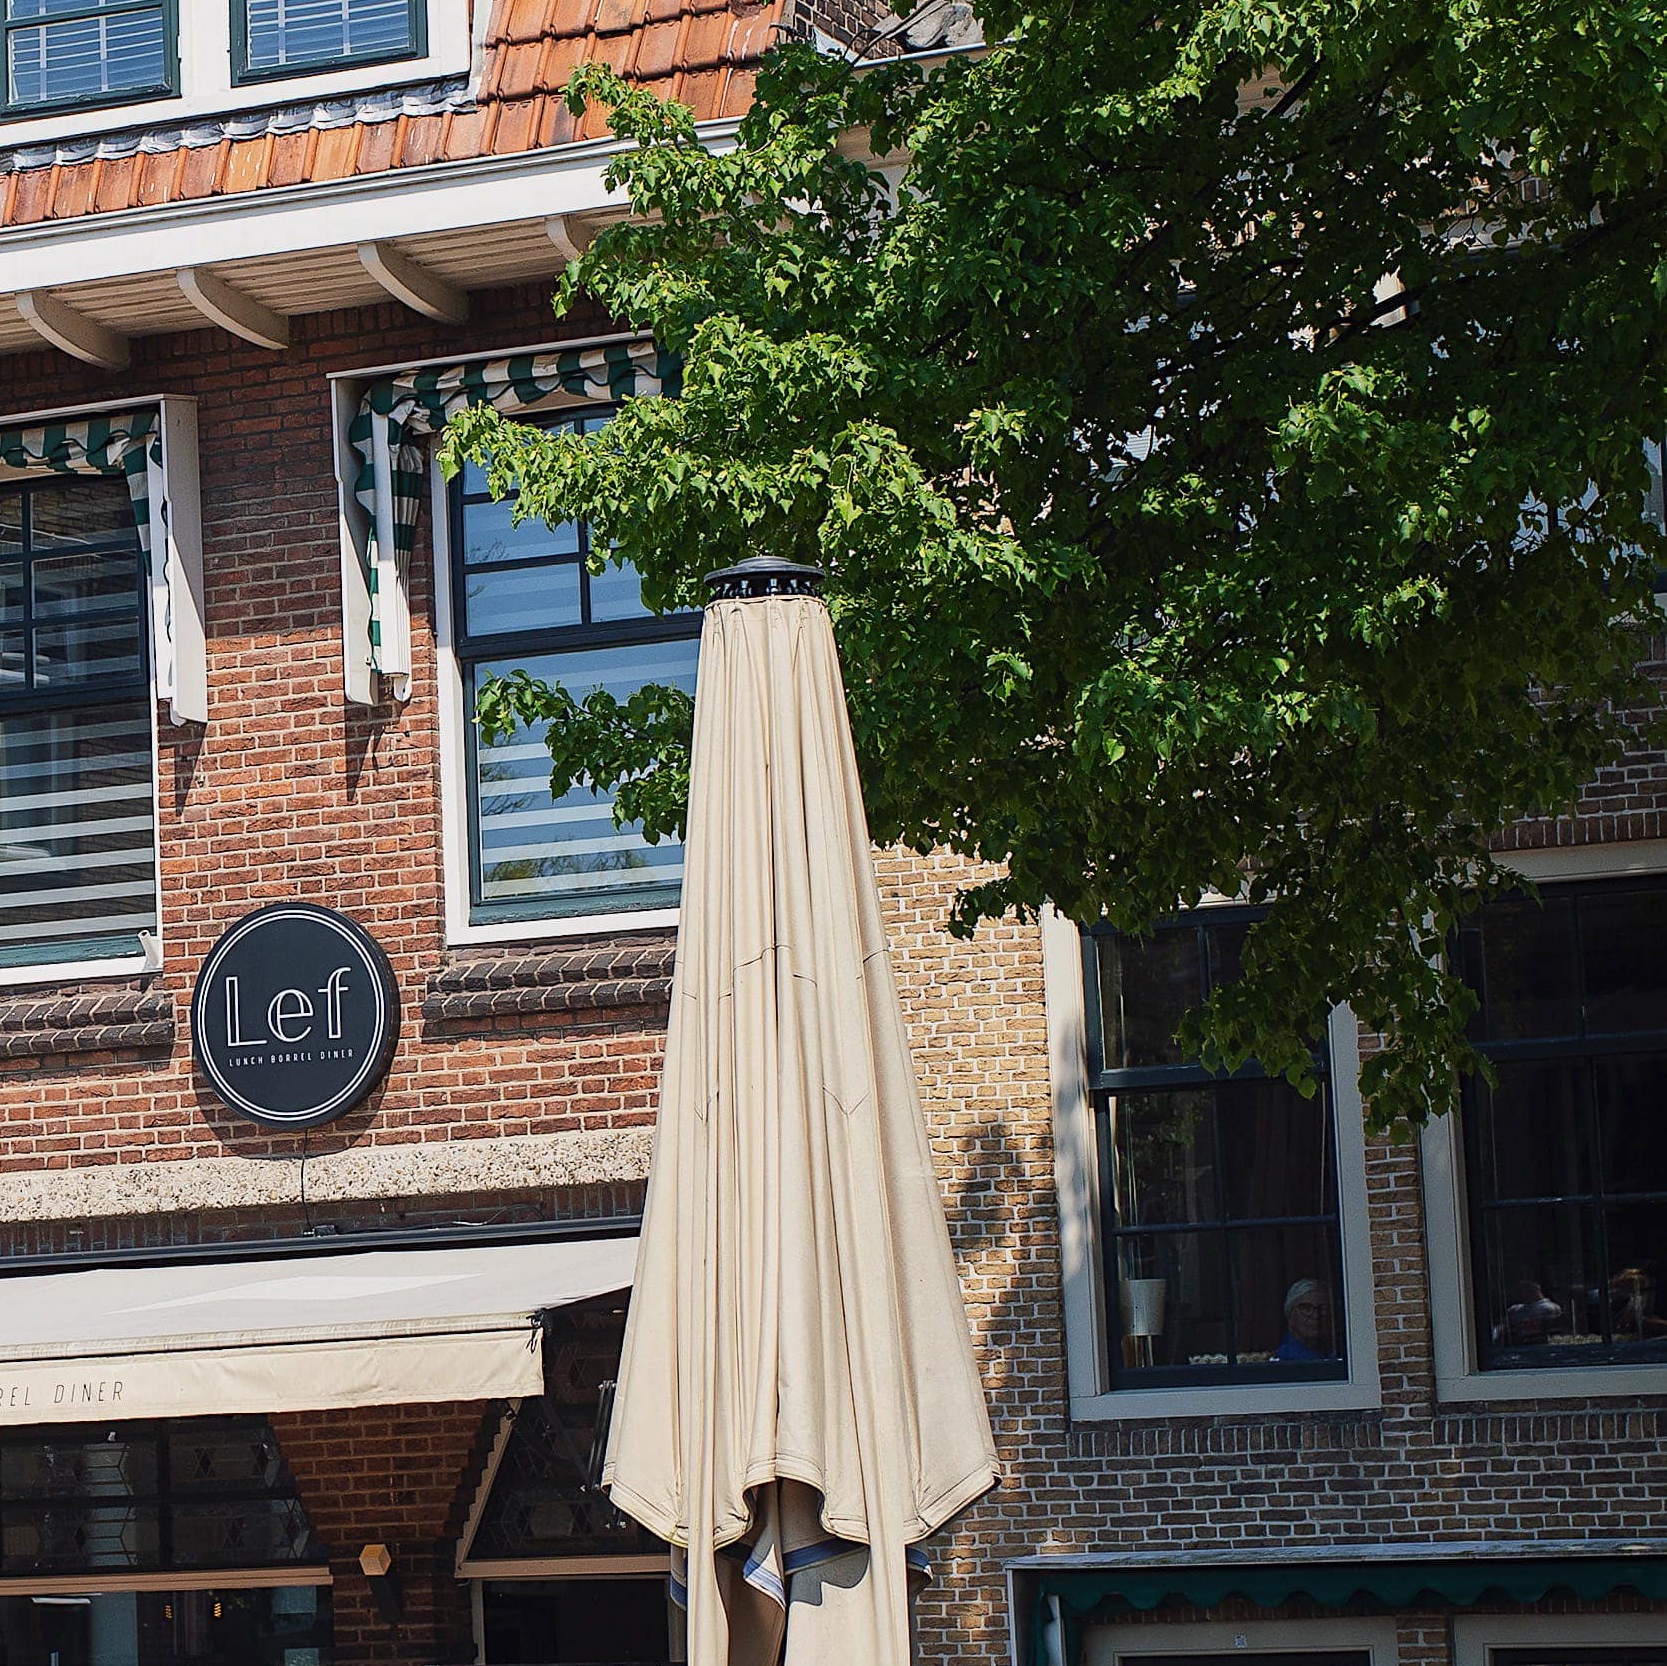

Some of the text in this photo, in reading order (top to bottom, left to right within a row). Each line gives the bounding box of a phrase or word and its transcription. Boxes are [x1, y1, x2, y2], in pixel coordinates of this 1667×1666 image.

[225, 966, 352, 1047] Lef
[228, 1048, 354, 1068] LUNCH BORREL DINER
[53, 1380, 124, 1405] DINER
